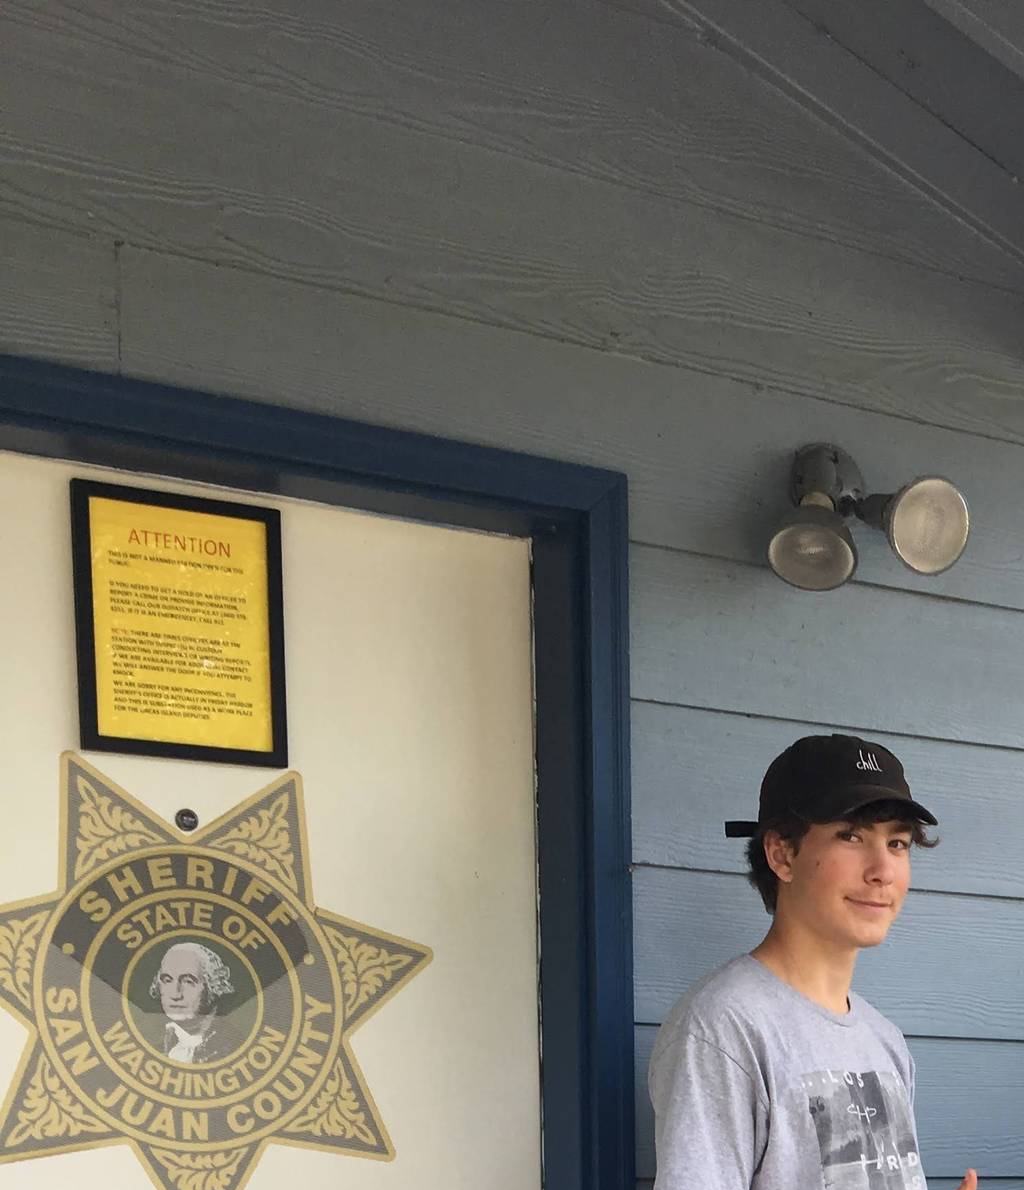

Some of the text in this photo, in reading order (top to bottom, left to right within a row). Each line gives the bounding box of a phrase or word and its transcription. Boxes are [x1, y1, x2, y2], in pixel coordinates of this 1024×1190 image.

[128, 528, 231, 558] ATTENTION
[856, 749, 882, 772] chill
[79, 856, 297, 928] SHERIFF
[117, 901, 265, 951] STATE OF
[46, 987, 332, 1141] SAN JUAN COUNTY
[101, 1025, 286, 1097] WASHINGTON
